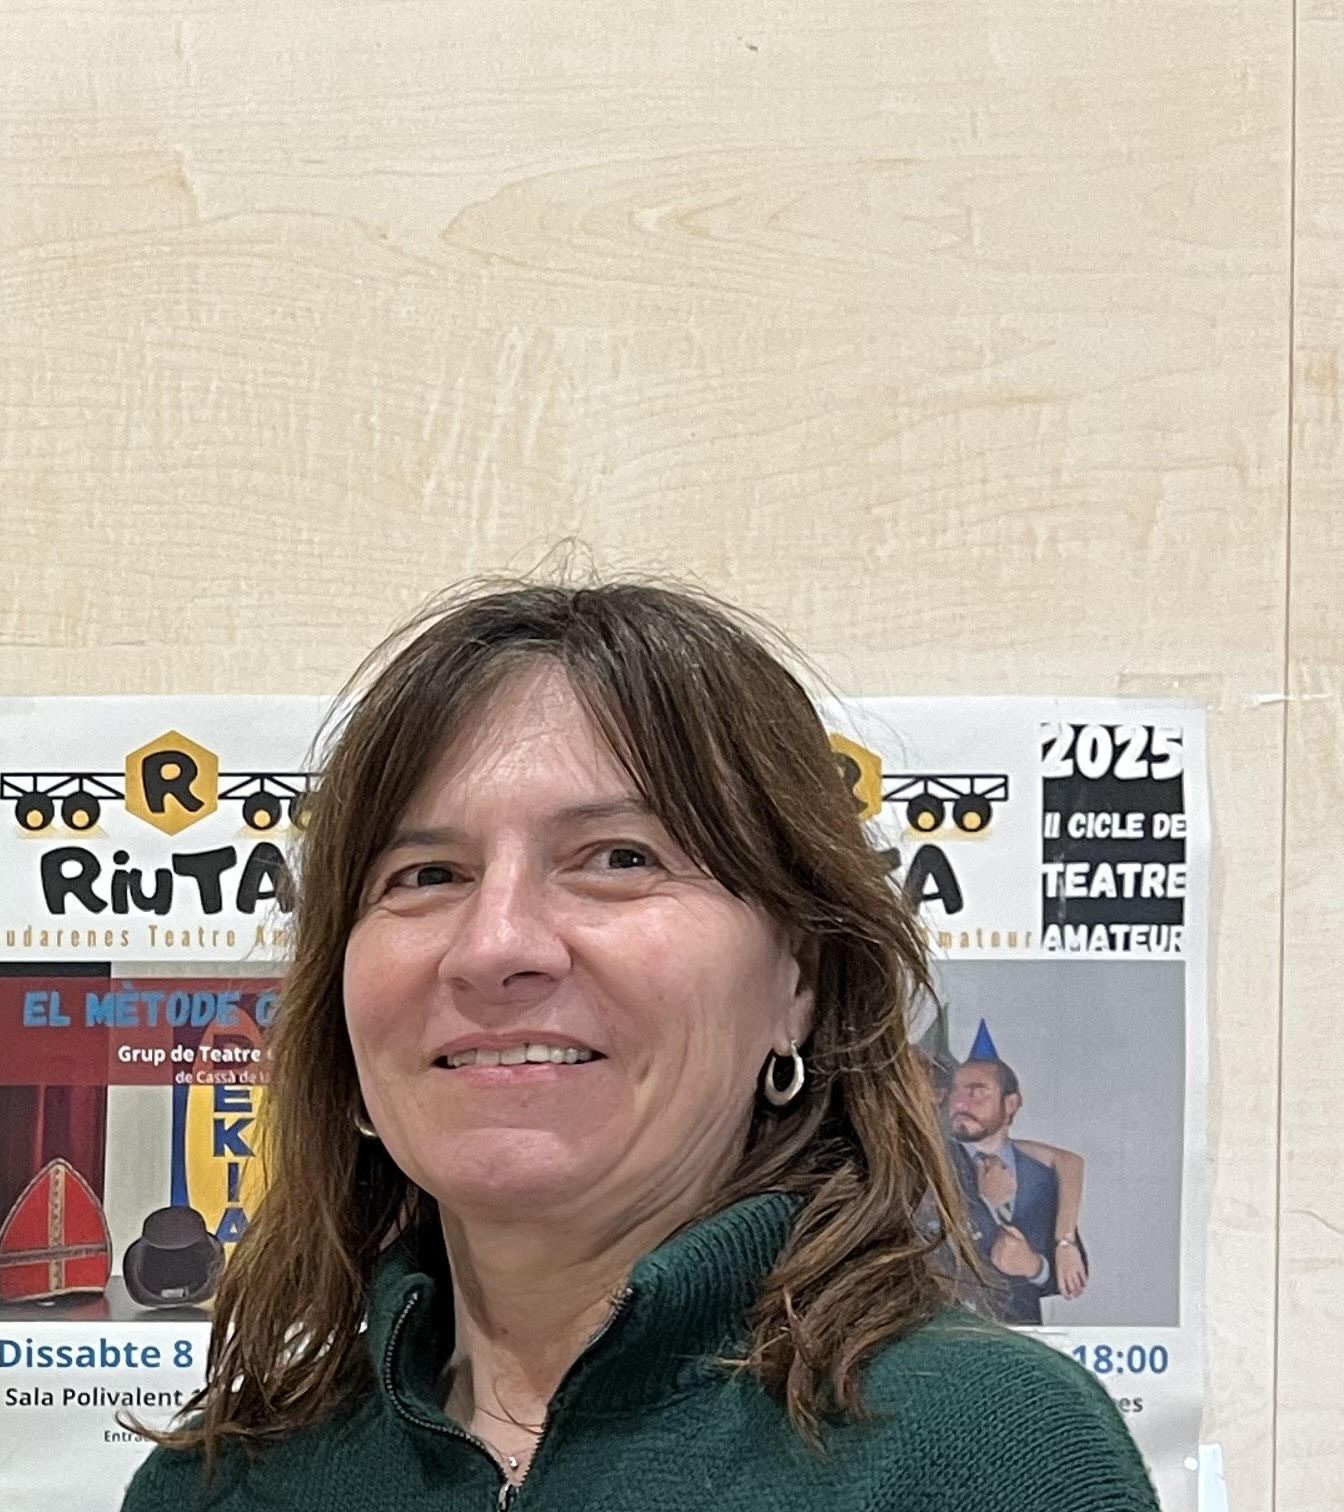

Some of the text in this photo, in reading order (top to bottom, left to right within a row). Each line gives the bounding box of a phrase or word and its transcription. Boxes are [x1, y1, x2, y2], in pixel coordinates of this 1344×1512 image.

[1041, 722, 1183, 780] 2025
[141, 749, 205, 813] R
[1045, 812, 1187, 839] II CICLE DE
[40, 841, 295, 916] RiuTA
[1042, 862, 1187, 900] TEATRE
[149, 924, 237, 948] Teatre
[926, 927, 1033, 949] mateur
[1041, 923, 1183, 952] AMATEUR
[23, 991, 71, 1027] EL
[85, 981, 242, 1028] MÈTODE
[118, 1045, 166, 1066] Grup
[170, 1045, 195, 1063] de
[200, 1046, 262, 1063] Teatre
[175, 1070, 192, 1084] de
[196, 1070, 236, 1084] Cassà
[173, 1340, 194, 1368] 8
[1072, 1344, 1169, 1375] 18:00
[5, 1387, 183, 1408] Sala Polivalent
